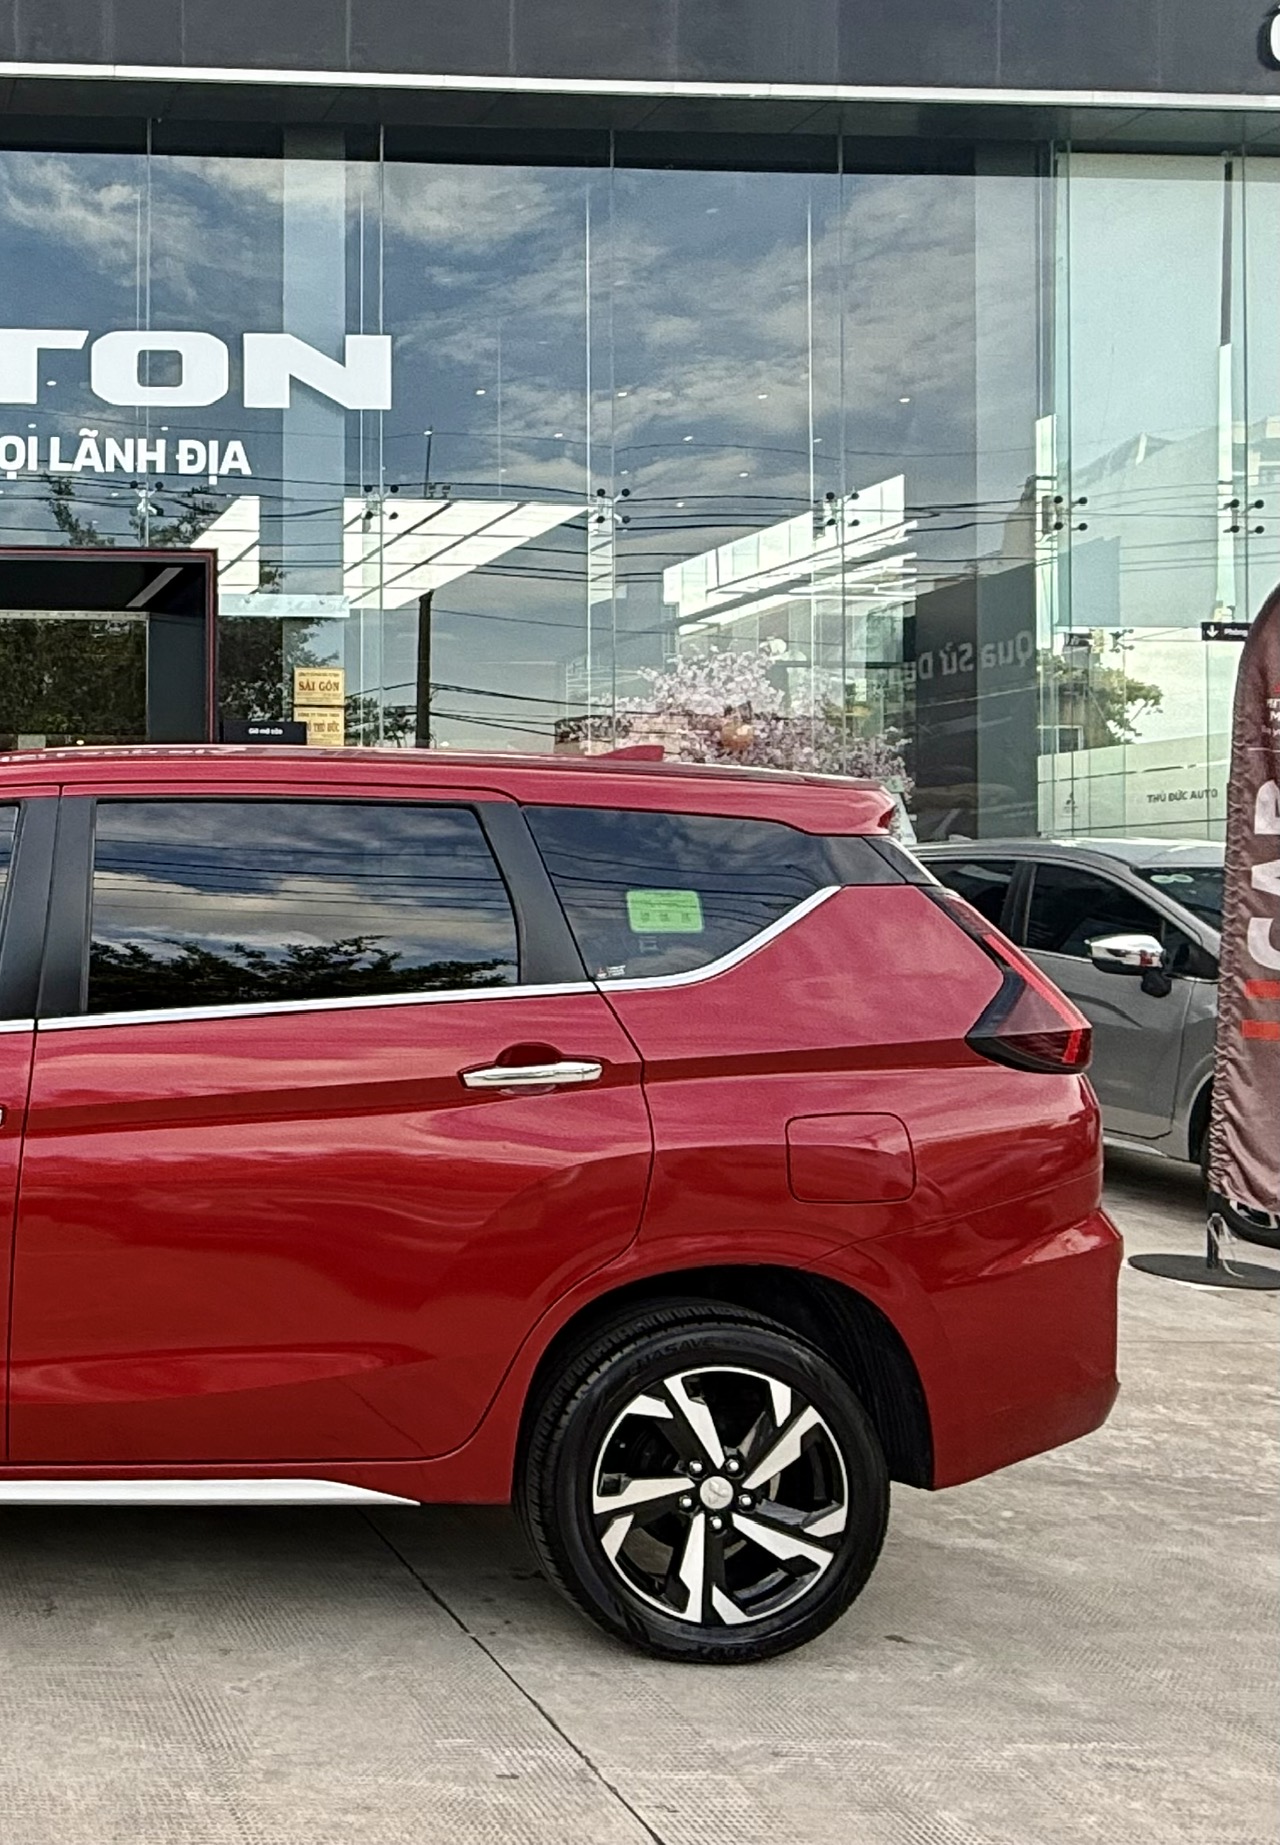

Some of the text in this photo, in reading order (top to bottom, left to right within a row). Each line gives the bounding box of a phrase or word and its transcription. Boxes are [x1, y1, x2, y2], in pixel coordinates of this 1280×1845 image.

[49, 428, 167, 475] LÃNH
[175, 438, 252, 486] ĐỊA
[1190, 788, 1218, 800] AUTO
